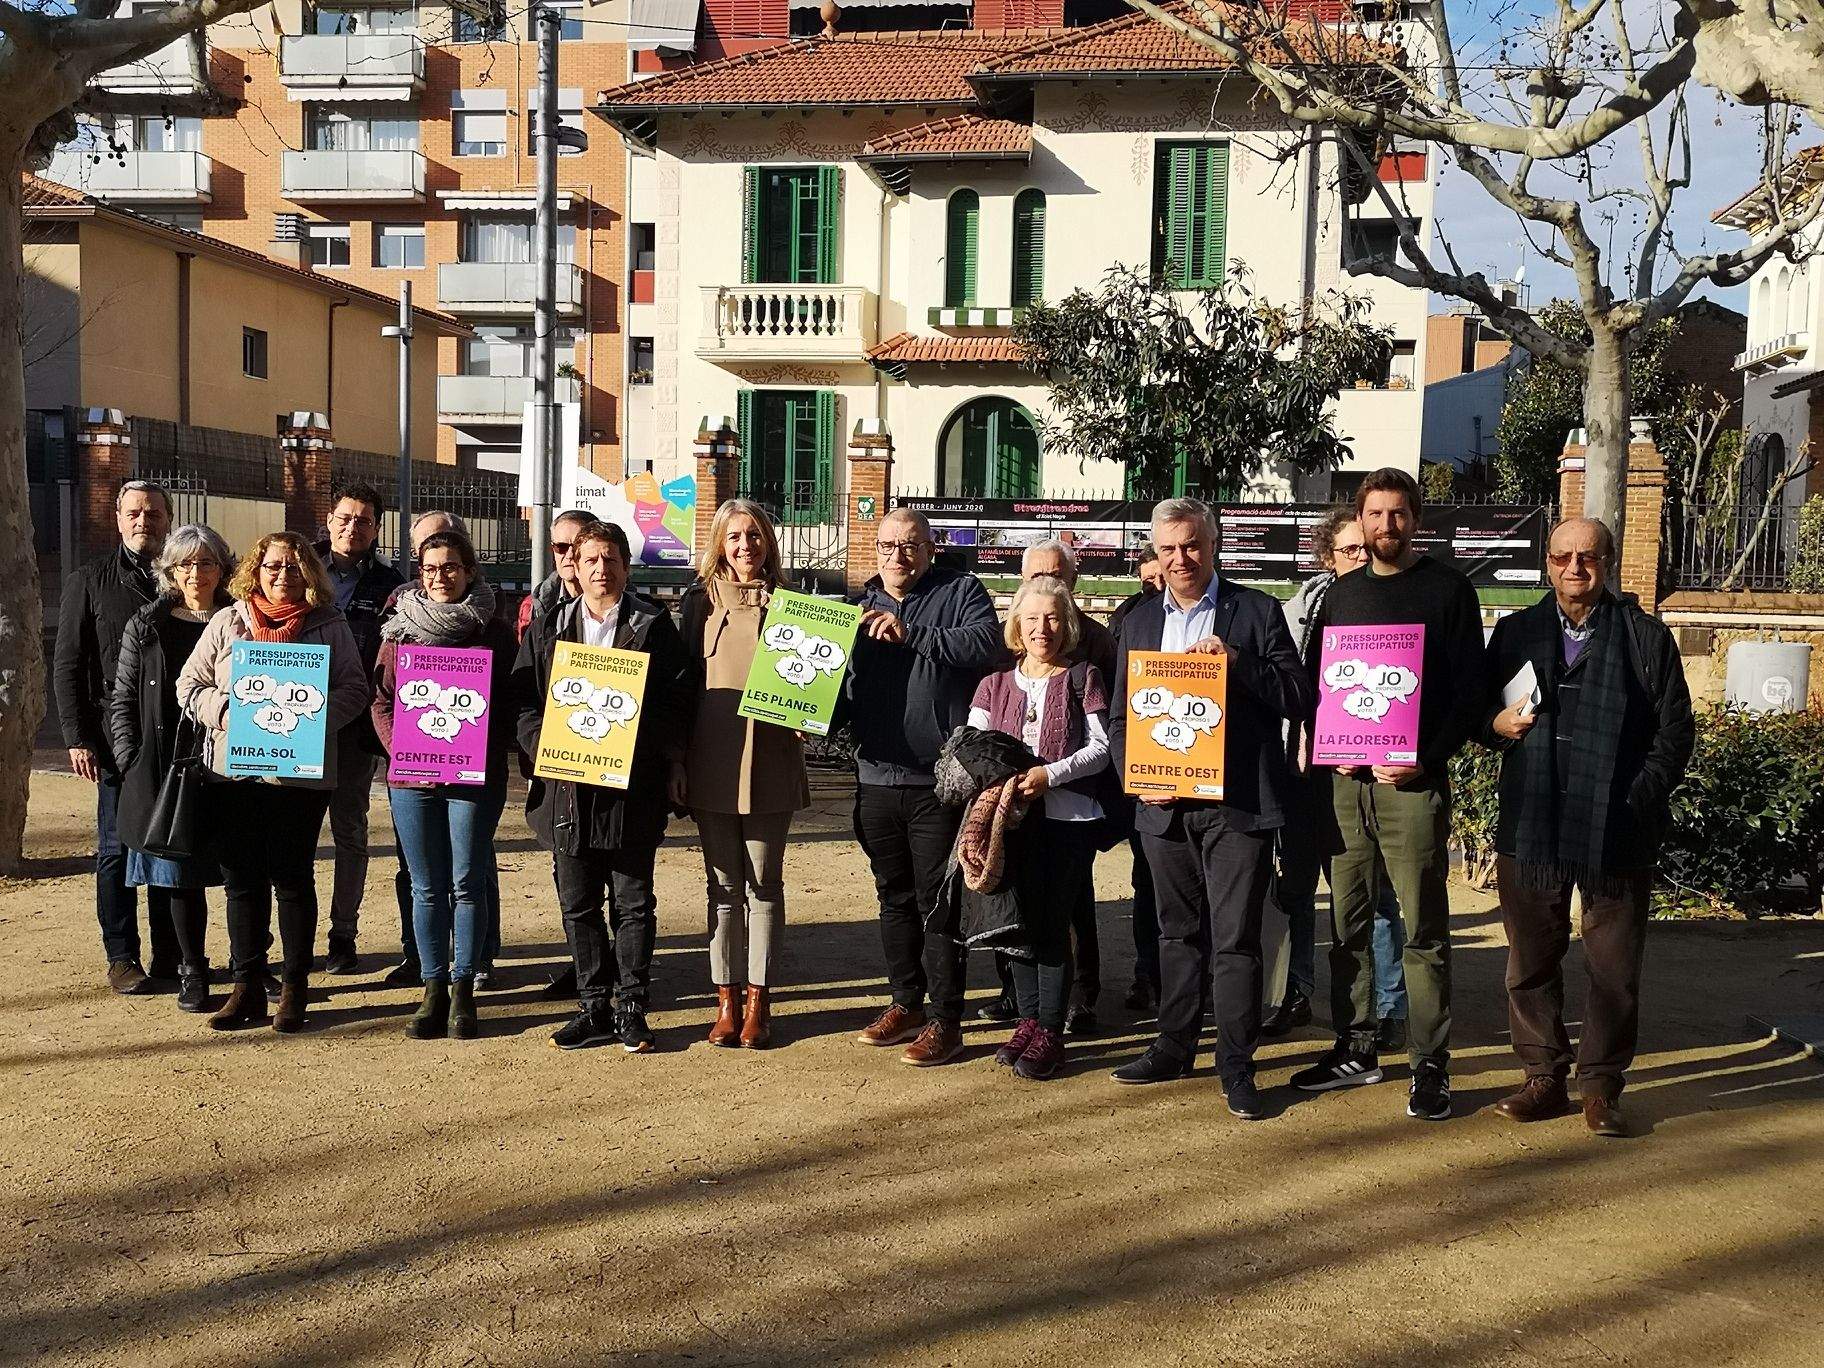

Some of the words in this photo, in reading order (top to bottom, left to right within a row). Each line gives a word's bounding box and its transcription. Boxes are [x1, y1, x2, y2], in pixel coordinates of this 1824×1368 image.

[576, 486, 606, 496] timat
[965, 504, 984, 512] 2020
[786, 600, 857, 622] PRESSUPOSTOS
[784, 608, 851, 628] PARTICIPATIUS
[775, 628, 794, 640] JO
[1340, 633, 1420, 643] PRESSUPOSTOS
[810, 643, 832, 658] JO
[1340, 642, 1415, 651] PARTICIPATIUS
[249, 650, 325, 661] PRESSUPOSTOS
[414, 654, 488, 666] PRESSUPOSTOS
[571, 652, 644, 669] PRESSUPOSTOS
[248, 658, 321, 668] PARTICIPATIUS
[414, 662, 484, 673] PARTICIPATIUS
[570, 660, 639, 676] PARTICIPATIUS
[788, 662, 804, 673] JO
[1146, 660, 1222, 670] PRESSUPOSTOS
[1146, 669, 1218, 680] PARTICIPATIUS
[1336, 665, 1355, 676] JO
[1378, 672, 1402, 686] JO
[245, 680, 264, 692] JO
[410, 684, 429, 696] JO
[564, 682, 582, 694] JO
[286, 688, 308, 702] JO
[450, 694, 472, 708] JO
[1142, 692, 1162, 704] JO
[602, 694, 624, 709] JO
[746, 689, 769, 703] LES
[770, 694, 818, 714] PLANES
[1358, 697, 1374, 708] JO
[1184, 702, 1206, 716] JO
[267, 712, 283, 722] JO
[430, 717, 447, 727] JO
[580, 716, 596, 726] JO
[1165, 726, 1180, 738] JO
[1319, 734, 1336, 745] LA
[1338, 734, 1408, 746] FLORESTA
[230, 746, 297, 758] MIRA-SOL
[542, 748, 580, 763] NUCLI
[583, 754, 623, 768] ANTIC
[396, 752, 446, 764] CENTRE
[448, 754, 472, 765] EST
[1130, 764, 1182, 776] CENTRE
[1184, 766, 1219, 778] OEST
